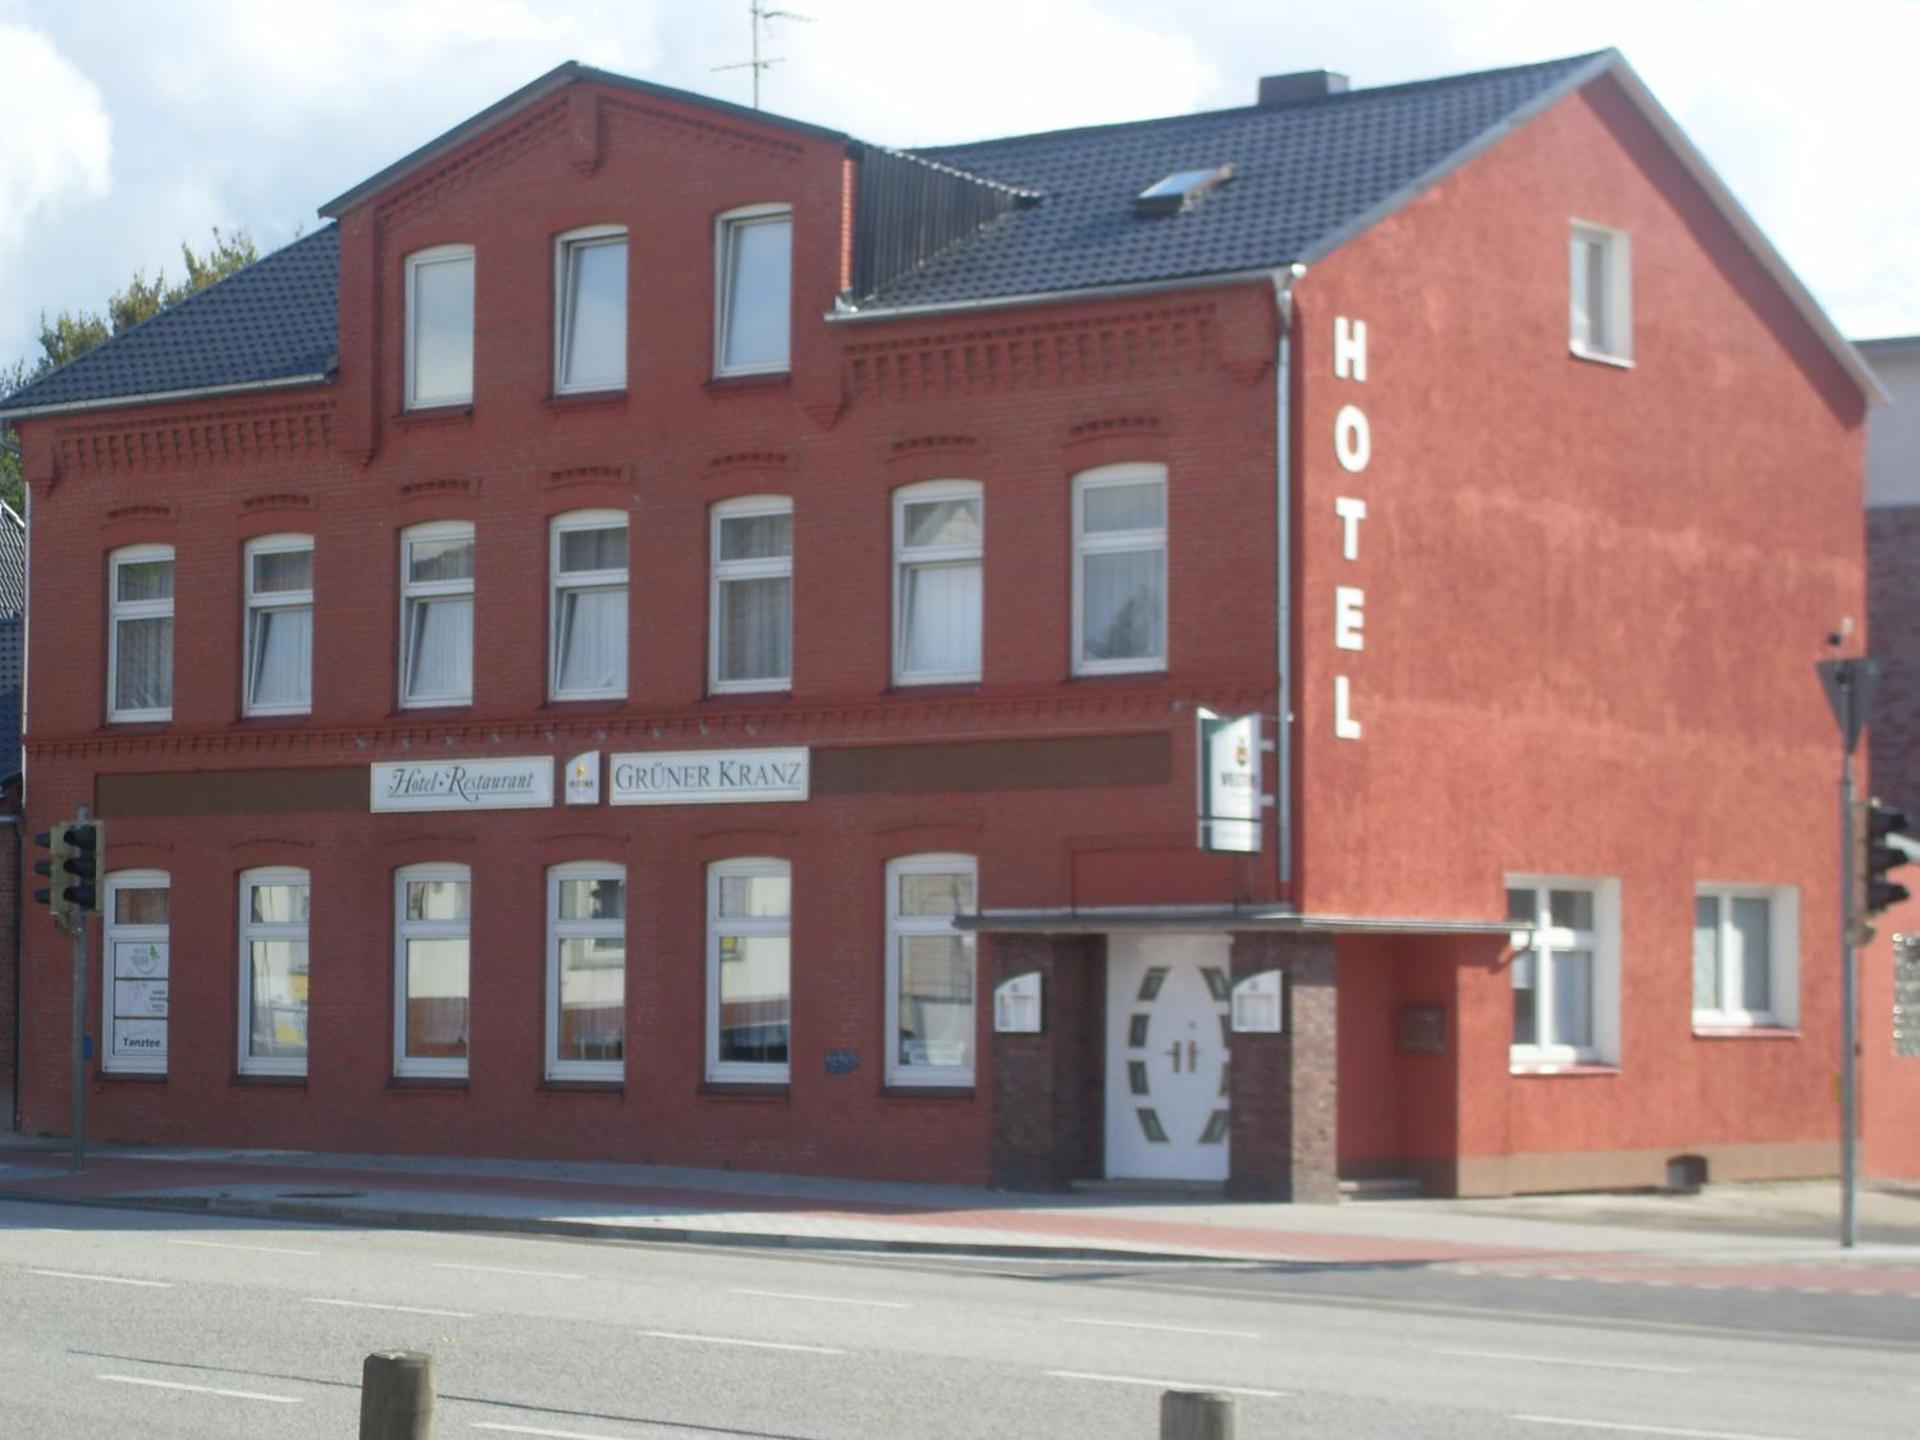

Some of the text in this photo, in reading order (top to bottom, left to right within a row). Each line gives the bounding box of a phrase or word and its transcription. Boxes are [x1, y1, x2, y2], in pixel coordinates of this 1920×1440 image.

[1333, 316, 1371, 740] HOTEL
[615, 761, 801, 790] GRÜNER KRANZ
